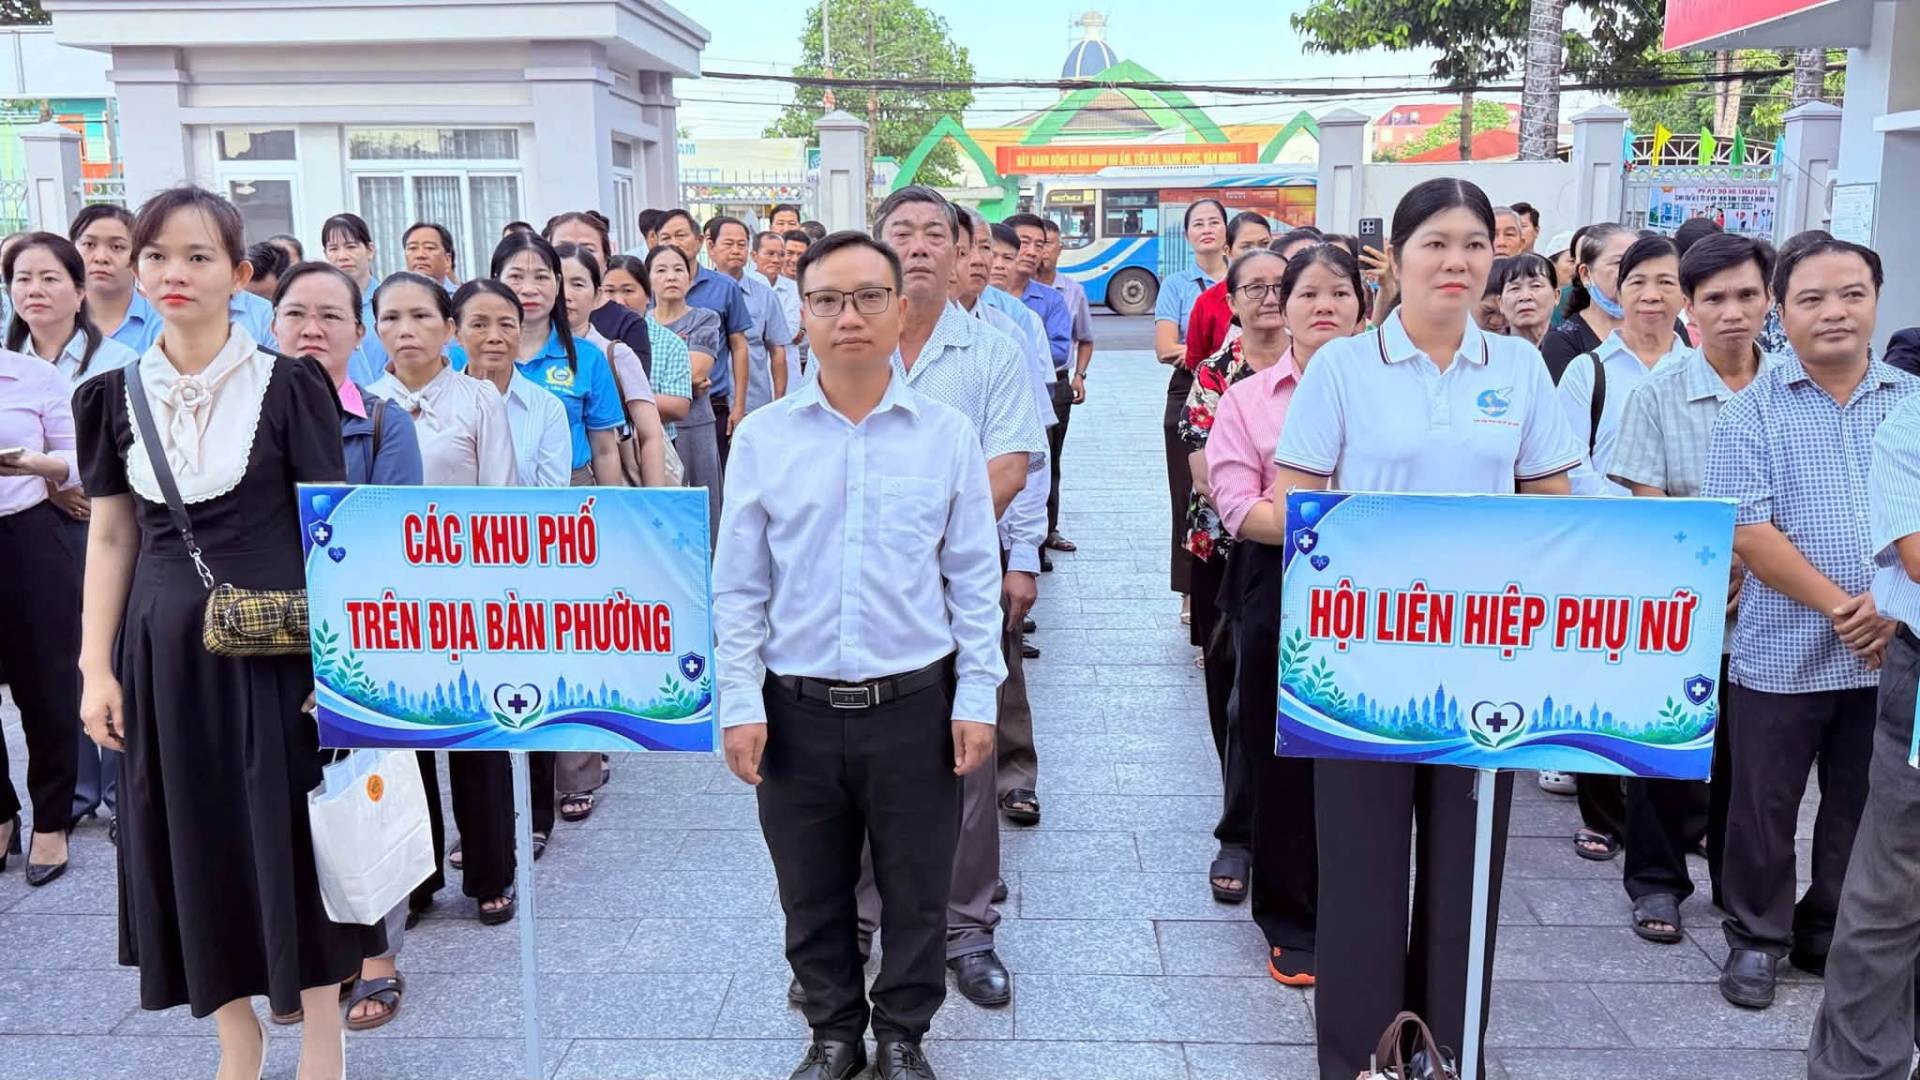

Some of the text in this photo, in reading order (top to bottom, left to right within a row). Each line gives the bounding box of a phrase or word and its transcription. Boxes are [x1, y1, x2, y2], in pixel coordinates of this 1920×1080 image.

[404, 498, 597, 565] CÁC KHU PHỐ
[347, 592, 672, 661] TRÊN ĐỊA BÀN PHƯỜNG
[1309, 579, 1698, 661] HỘI LIÊN HIỆP PHỤ NỮ
